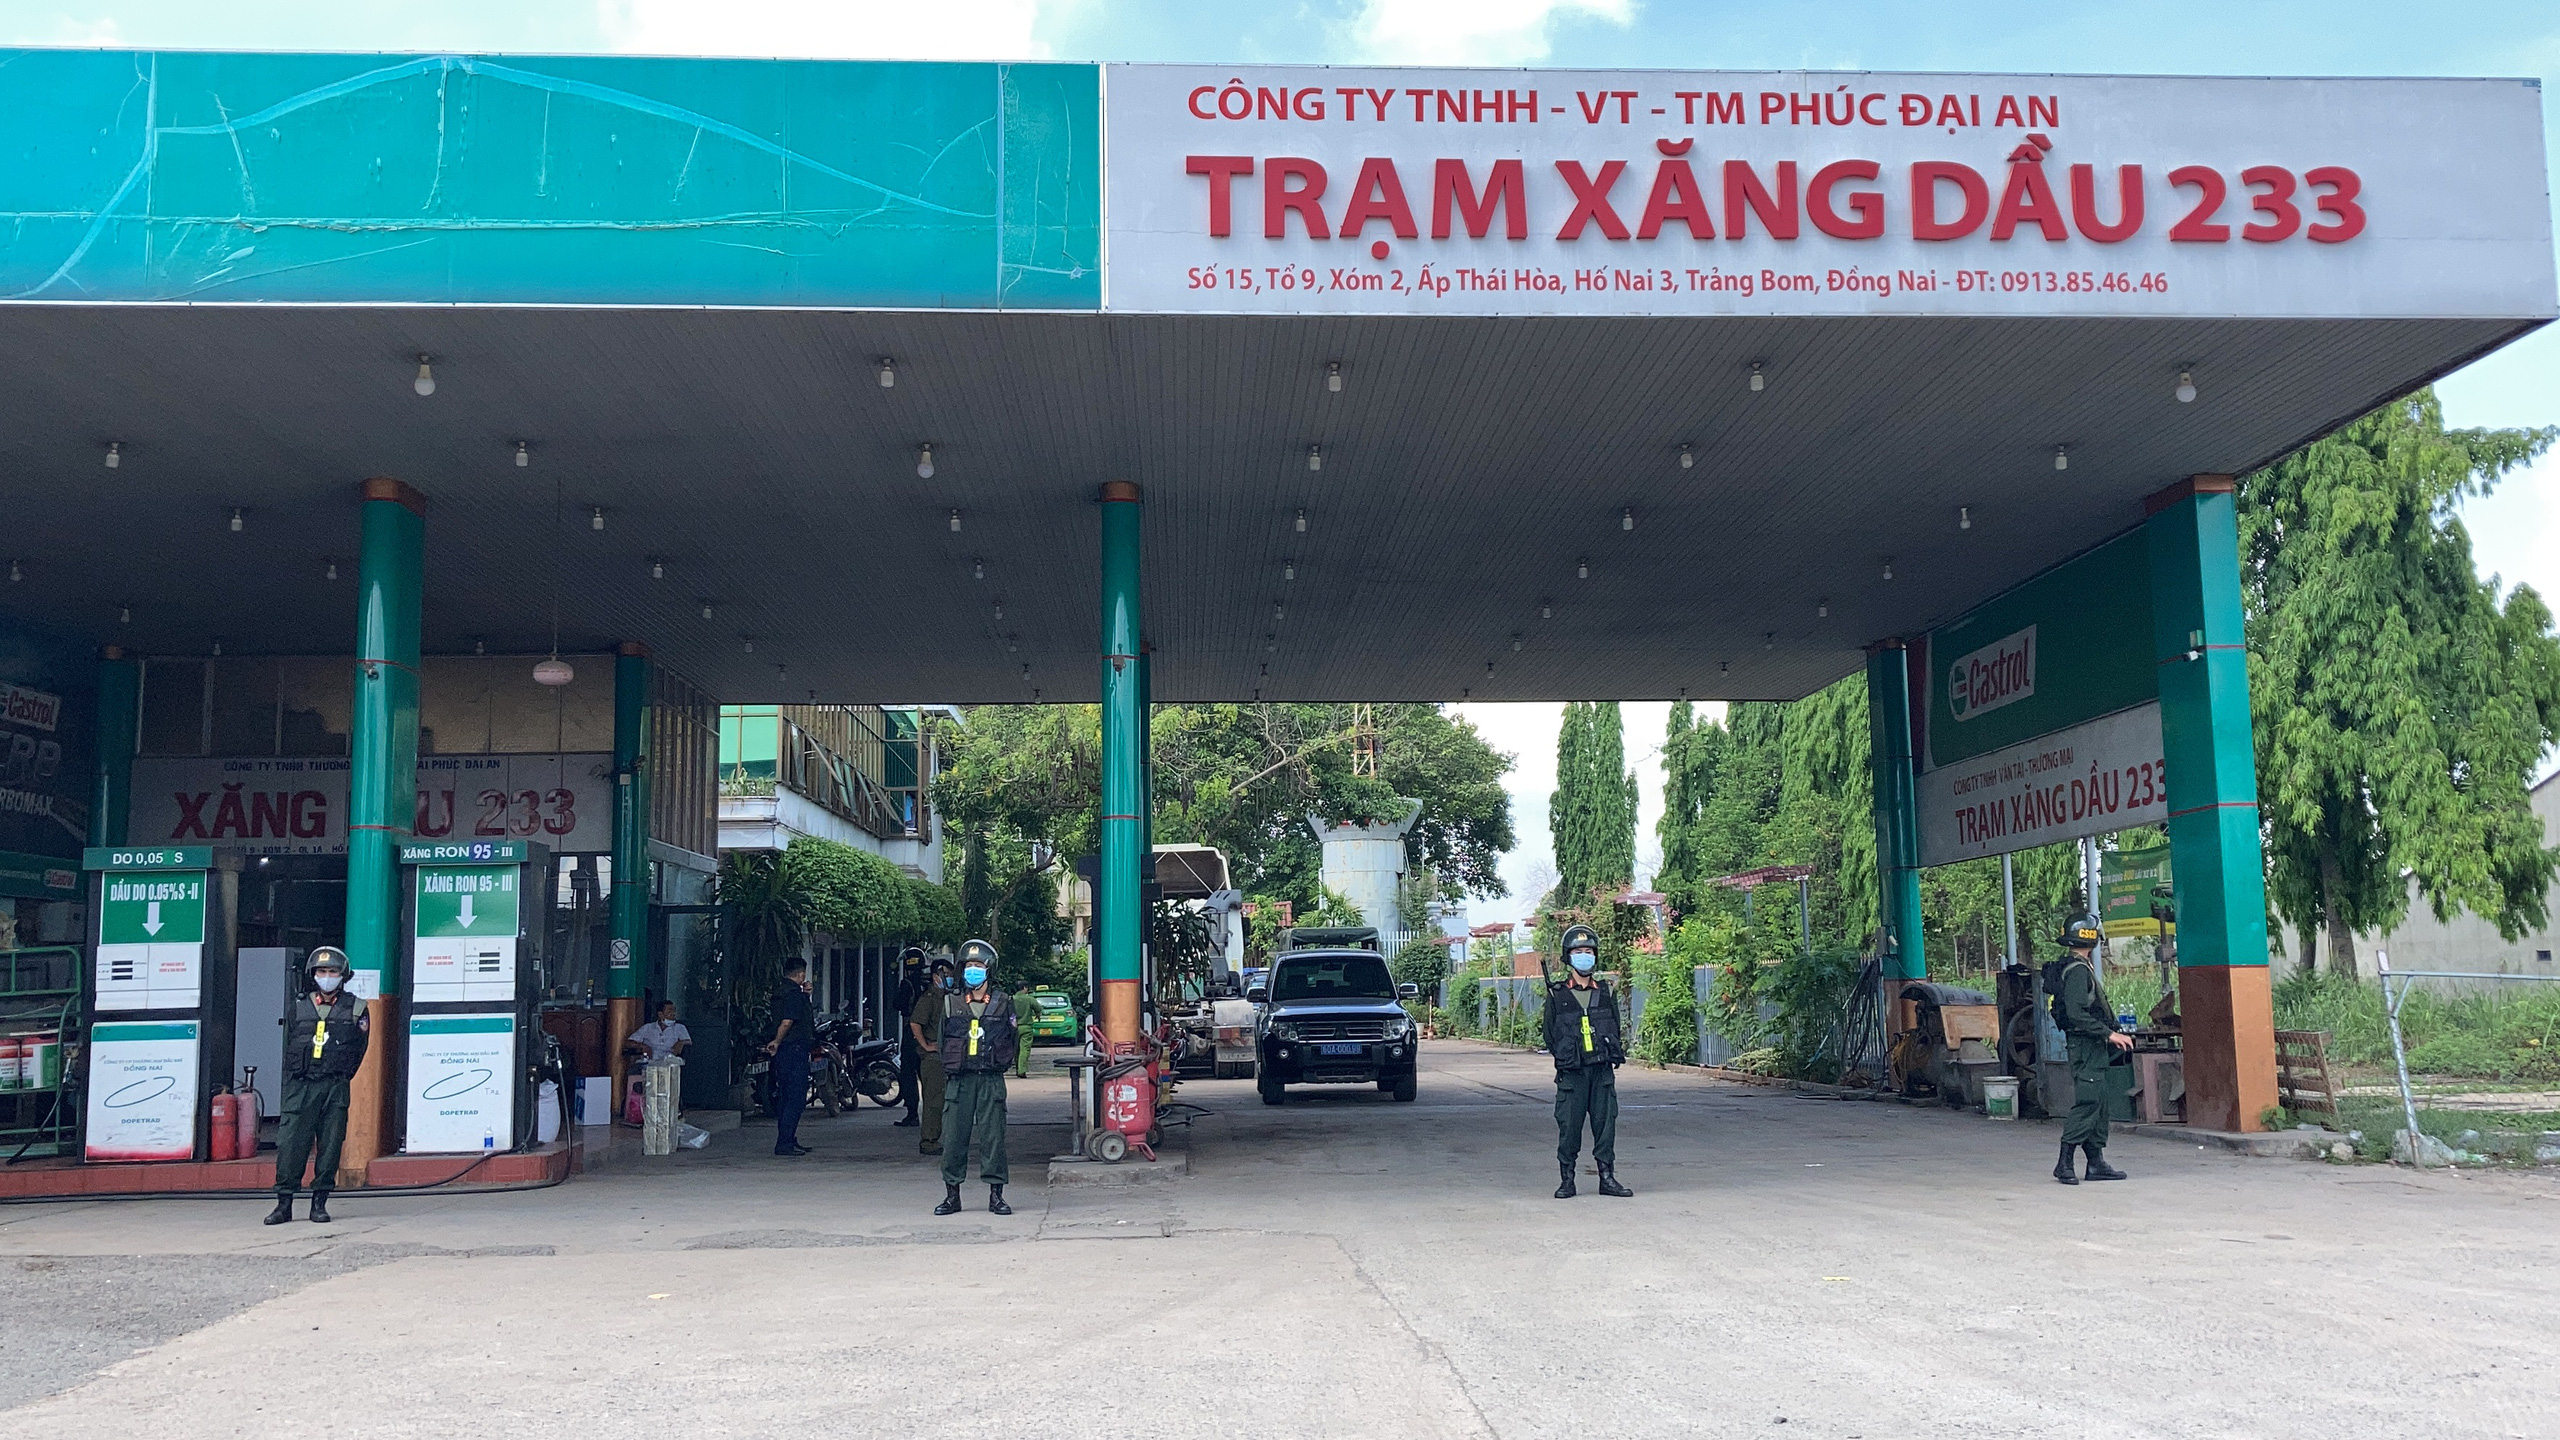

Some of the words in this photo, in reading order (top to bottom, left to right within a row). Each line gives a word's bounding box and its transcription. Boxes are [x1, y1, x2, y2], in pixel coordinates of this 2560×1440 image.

[1187, 77, 1325, 121] CÔNG
[1336, 88, 1396, 122] TY
[1406, 88, 1538, 123] TNHH
[1576, 91, 1639, 124] VT
[1675, 91, 1746, 125] TM
[1760, 84, 1888, 127] PHÚC
[1899, 94, 1981, 135] ĐẠI
[1994, 95, 2060, 128] AN
[1186, 155, 1528, 260] TRẠM
[1554, 137, 1886, 241] XĂNG
[1909, 133, 2146, 243] DẦU
[2168, 165, 2368, 244] 233
[1188, 263, 1218, 292] Số
[1226, 268, 1262, 294] 15,
[1265, 264, 1296, 292] Tổ
[1301, 268, 1324, 295] 9,
[1329, 267, 1384, 292] Xóm
[1390, 268, 1411, 296] 2,
[1418, 262, 1451, 297] Ấp
[1456, 267, 1507, 292] Thái
[1514, 268, 1567, 295] Hòa,
[1574, 264, 1608, 292] Hố
[1614, 268, 1653, 292] Nai
[1659, 269, 1680, 294] 3,
[1685, 267, 1754, 297] Trảng
[1761, 270, 1820, 296] Bom,
[1826, 265, 1892, 297] Đồng
[1898, 269, 1937, 292] Nai
[1957, 270, 1996, 292] ĐT:
[2001, 271, 2169, 293] 0913.85.46.46
[1968, 637, 2031, 710] Castrol
[7, 690, 55, 726] Castrol
[486, 759, 501, 769] AN
[171, 781, 328, 840] XĂNG
[474, 788, 577, 837] 233
[1955, 797, 2007, 849] TRẠM
[2011, 782, 2066, 834] XĂNG
[2071, 759, 2119, 821] DẦU
[2126, 758, 2168, 810] 233
[112, 853, 133, 865] DO
[135, 852, 164, 866] 0,05
[174, 851, 184, 863] S
[403, 847, 431, 859] XĂNG
[434, 846, 470, 858] RON
[473, 844, 492, 860] 95
[110, 878, 131, 901] DẦU
[132, 883, 147, 900] DO
[424, 872, 453, 893] XĂNG
[455, 875, 477, 892] RON
[479, 874, 493, 892] 95
[501, 874, 513, 892] III
